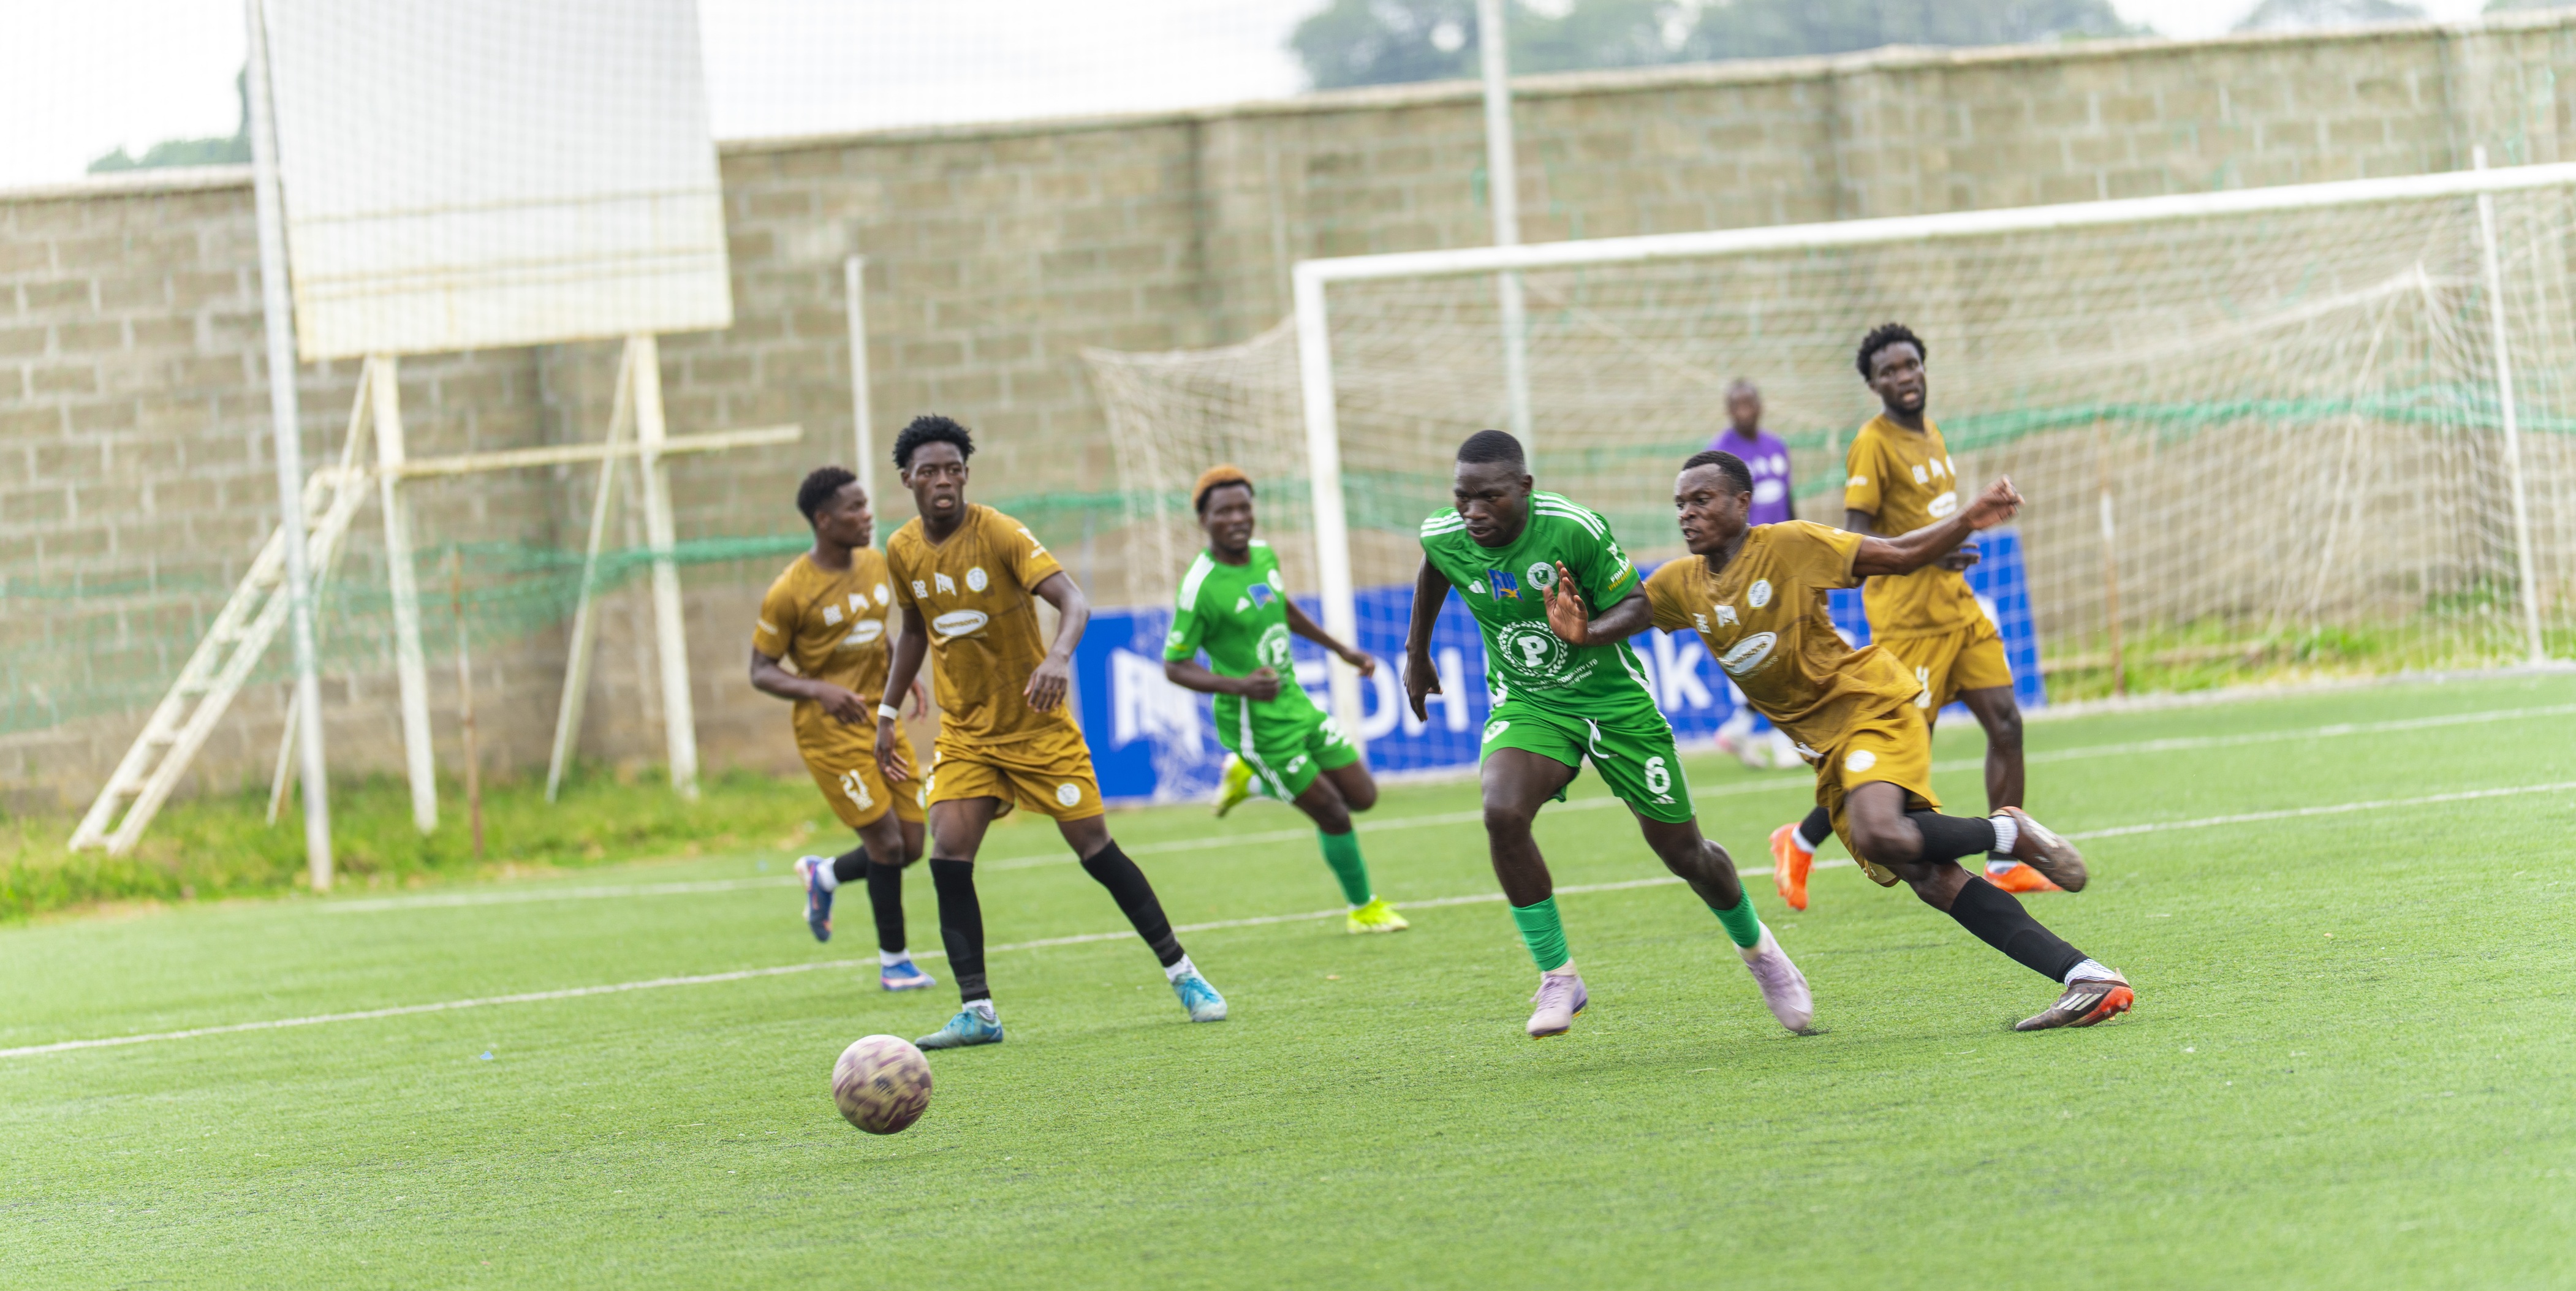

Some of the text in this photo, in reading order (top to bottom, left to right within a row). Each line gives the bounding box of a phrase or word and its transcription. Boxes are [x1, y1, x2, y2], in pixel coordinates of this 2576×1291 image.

[1517, 635, 1548, 667] P
[839, 769, 869, 799] 21
[1645, 757, 1671, 794] 6
